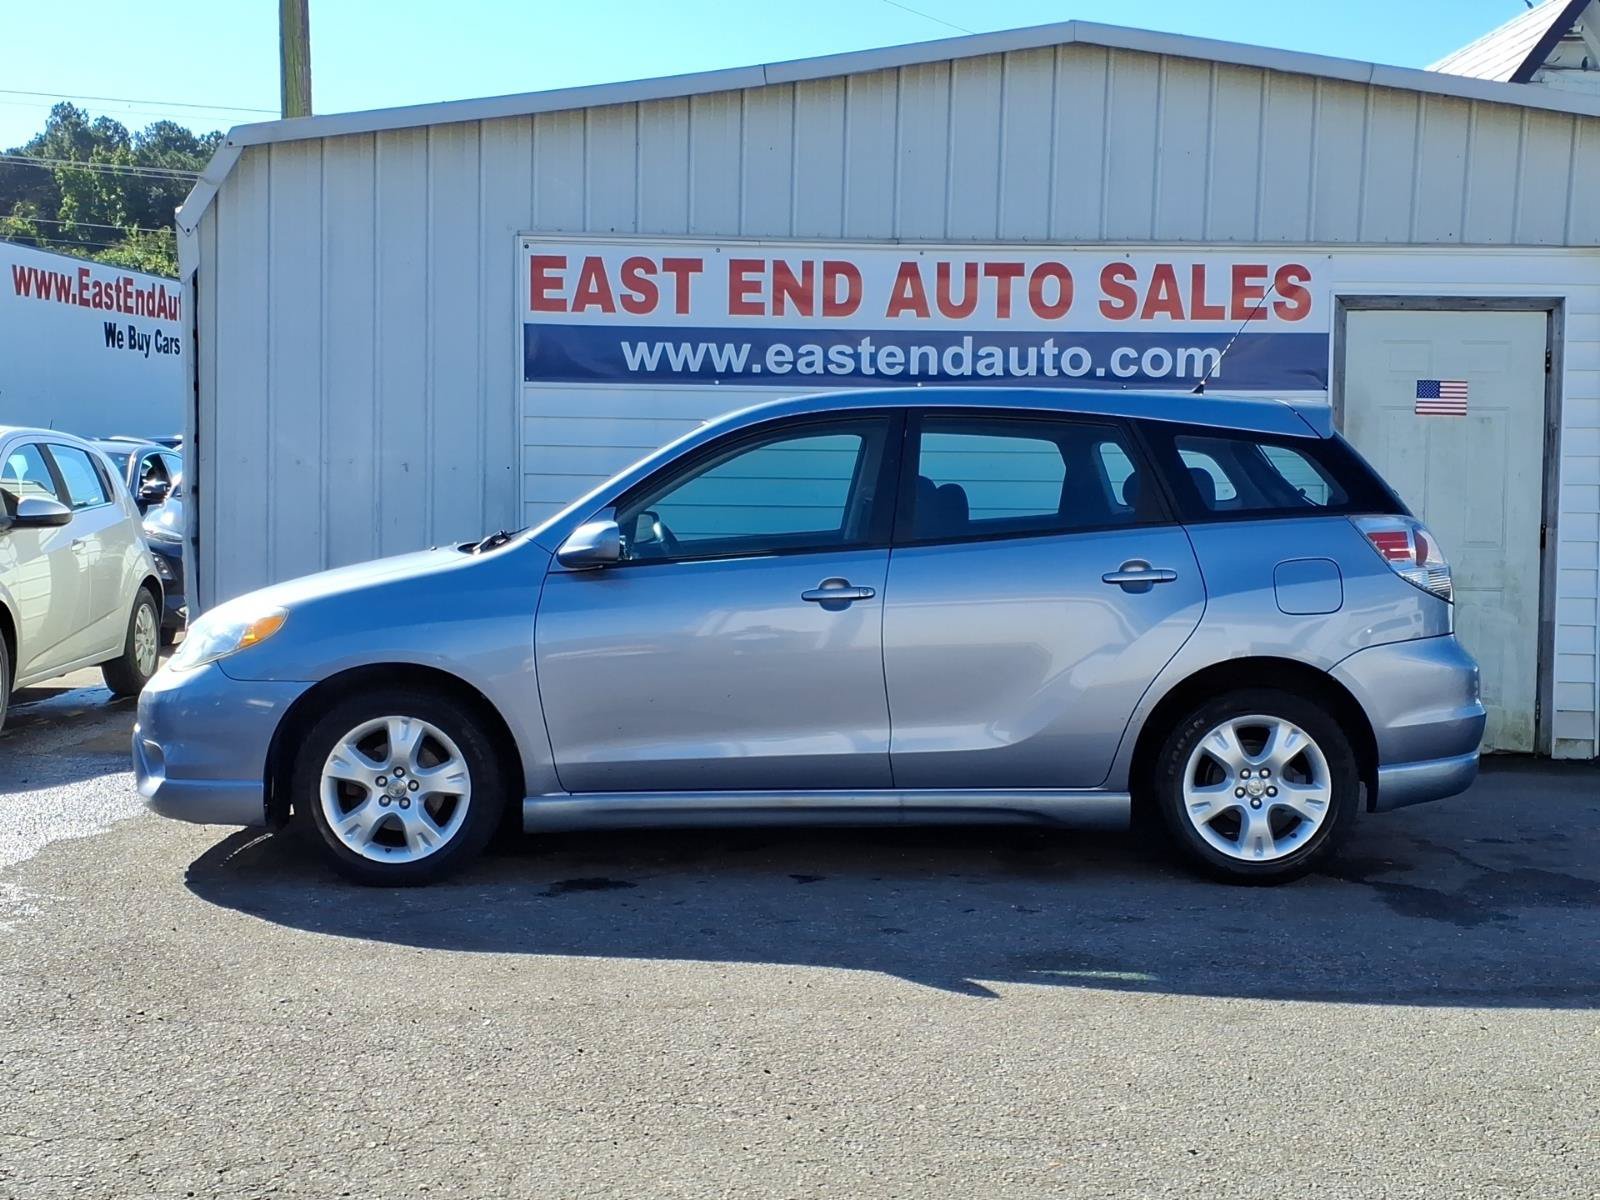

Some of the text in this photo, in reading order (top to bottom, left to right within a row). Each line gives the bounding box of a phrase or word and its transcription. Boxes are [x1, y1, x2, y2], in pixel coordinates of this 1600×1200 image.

[529, 255, 1312, 322] EAST END AUTO SALES
[104, 321, 181, 358] We Buy Cars
[620, 336, 1221, 378] www.eastendauto.com
